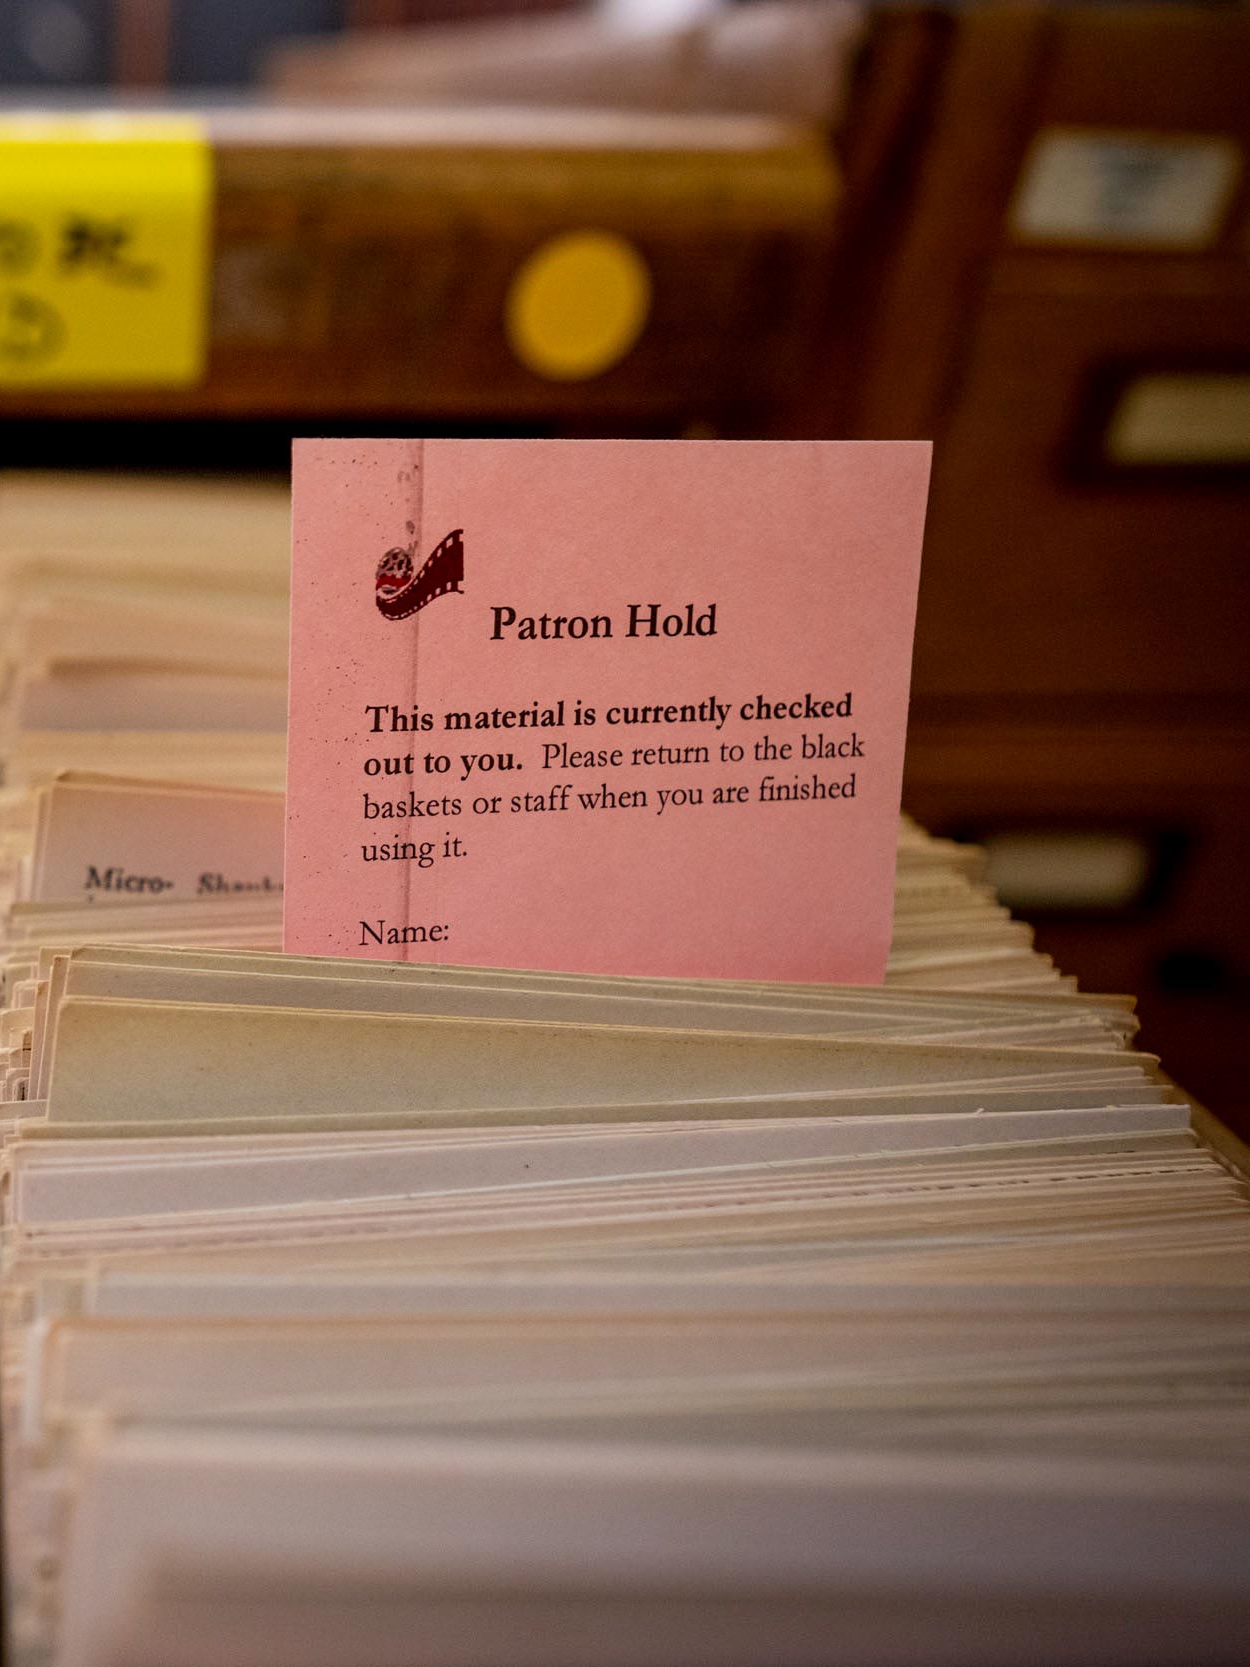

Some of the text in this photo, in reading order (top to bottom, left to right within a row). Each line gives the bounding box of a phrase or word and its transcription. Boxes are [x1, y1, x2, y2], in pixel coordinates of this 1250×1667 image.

[490, 603, 718, 641] Patron Hold
[365, 692, 852, 732] This material is currently checked
[363, 732, 866, 782] out to you. Please return to the black
[363, 773, 857, 820] baskets or staff when you are finished
[361, 832, 468, 868] using it.
[84, 865, 174, 893] Micro-
[358, 921, 450, 946] Name:
